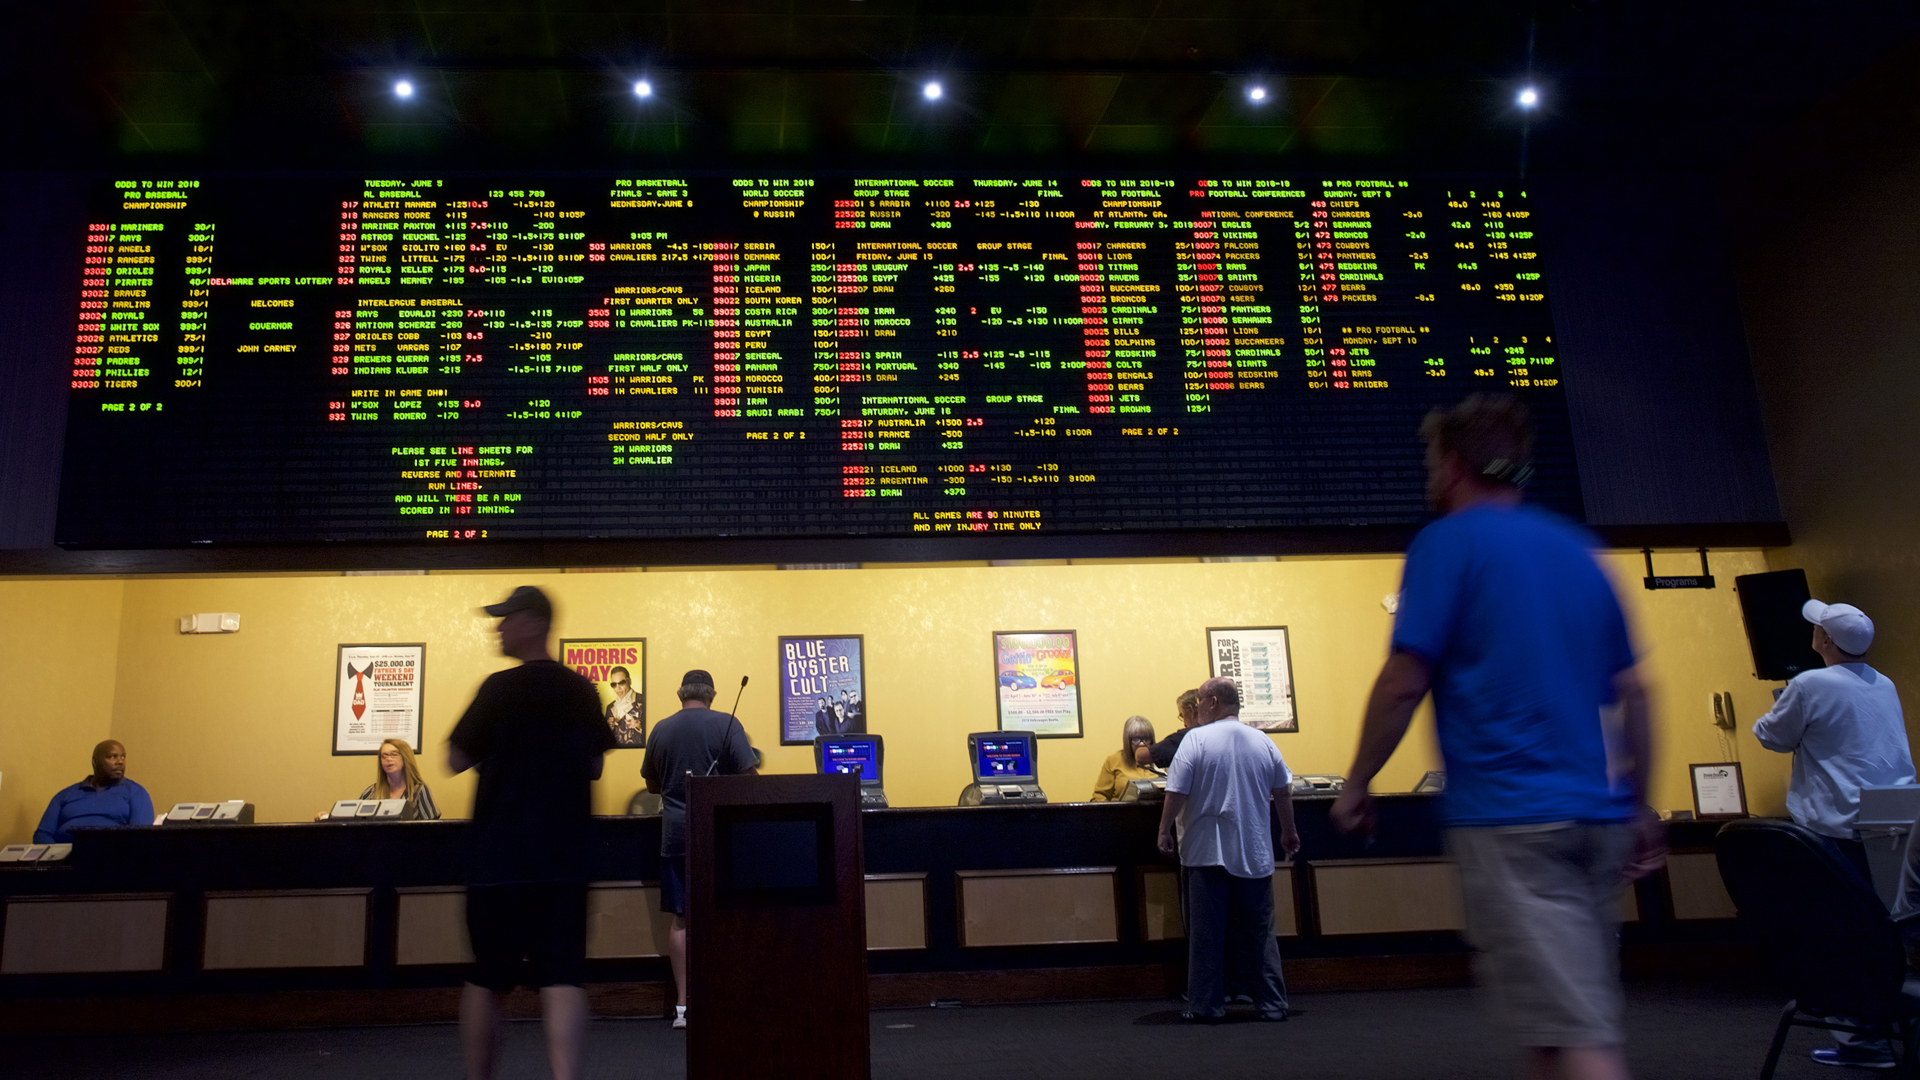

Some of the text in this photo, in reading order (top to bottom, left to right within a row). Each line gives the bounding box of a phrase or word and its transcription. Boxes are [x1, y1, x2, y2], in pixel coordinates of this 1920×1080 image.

[143, 323, 159, 331] SOX
[249, 322, 292, 330] GOVERNOR
[129, 403, 135, 411] 2
[140, 403, 151, 411] OF
[156, 403, 162, 411] 2
[392, 447, 425, 455] PLEASE
[430, 447, 446, 455] SEE
[452, 447, 474, 455] LINE
[462, 458, 504, 466] INNINGS,
[466, 470, 516, 478] ALTERNATE
[450, 482, 482, 490] LINES,
[445, 494, 472, 502] THERE
[966, 511, 983, 519] ARE
[987, 511, 998, 519] 90
[957, 523, 988, 531] INJURY
[1656, 578, 1697, 588] Programs
[785, 640, 826, 660] BLUE
[567, 648, 637, 665] MORRIS
[1232, 639, 1242, 677] MONEY
[790, 676, 827, 696] CULT
